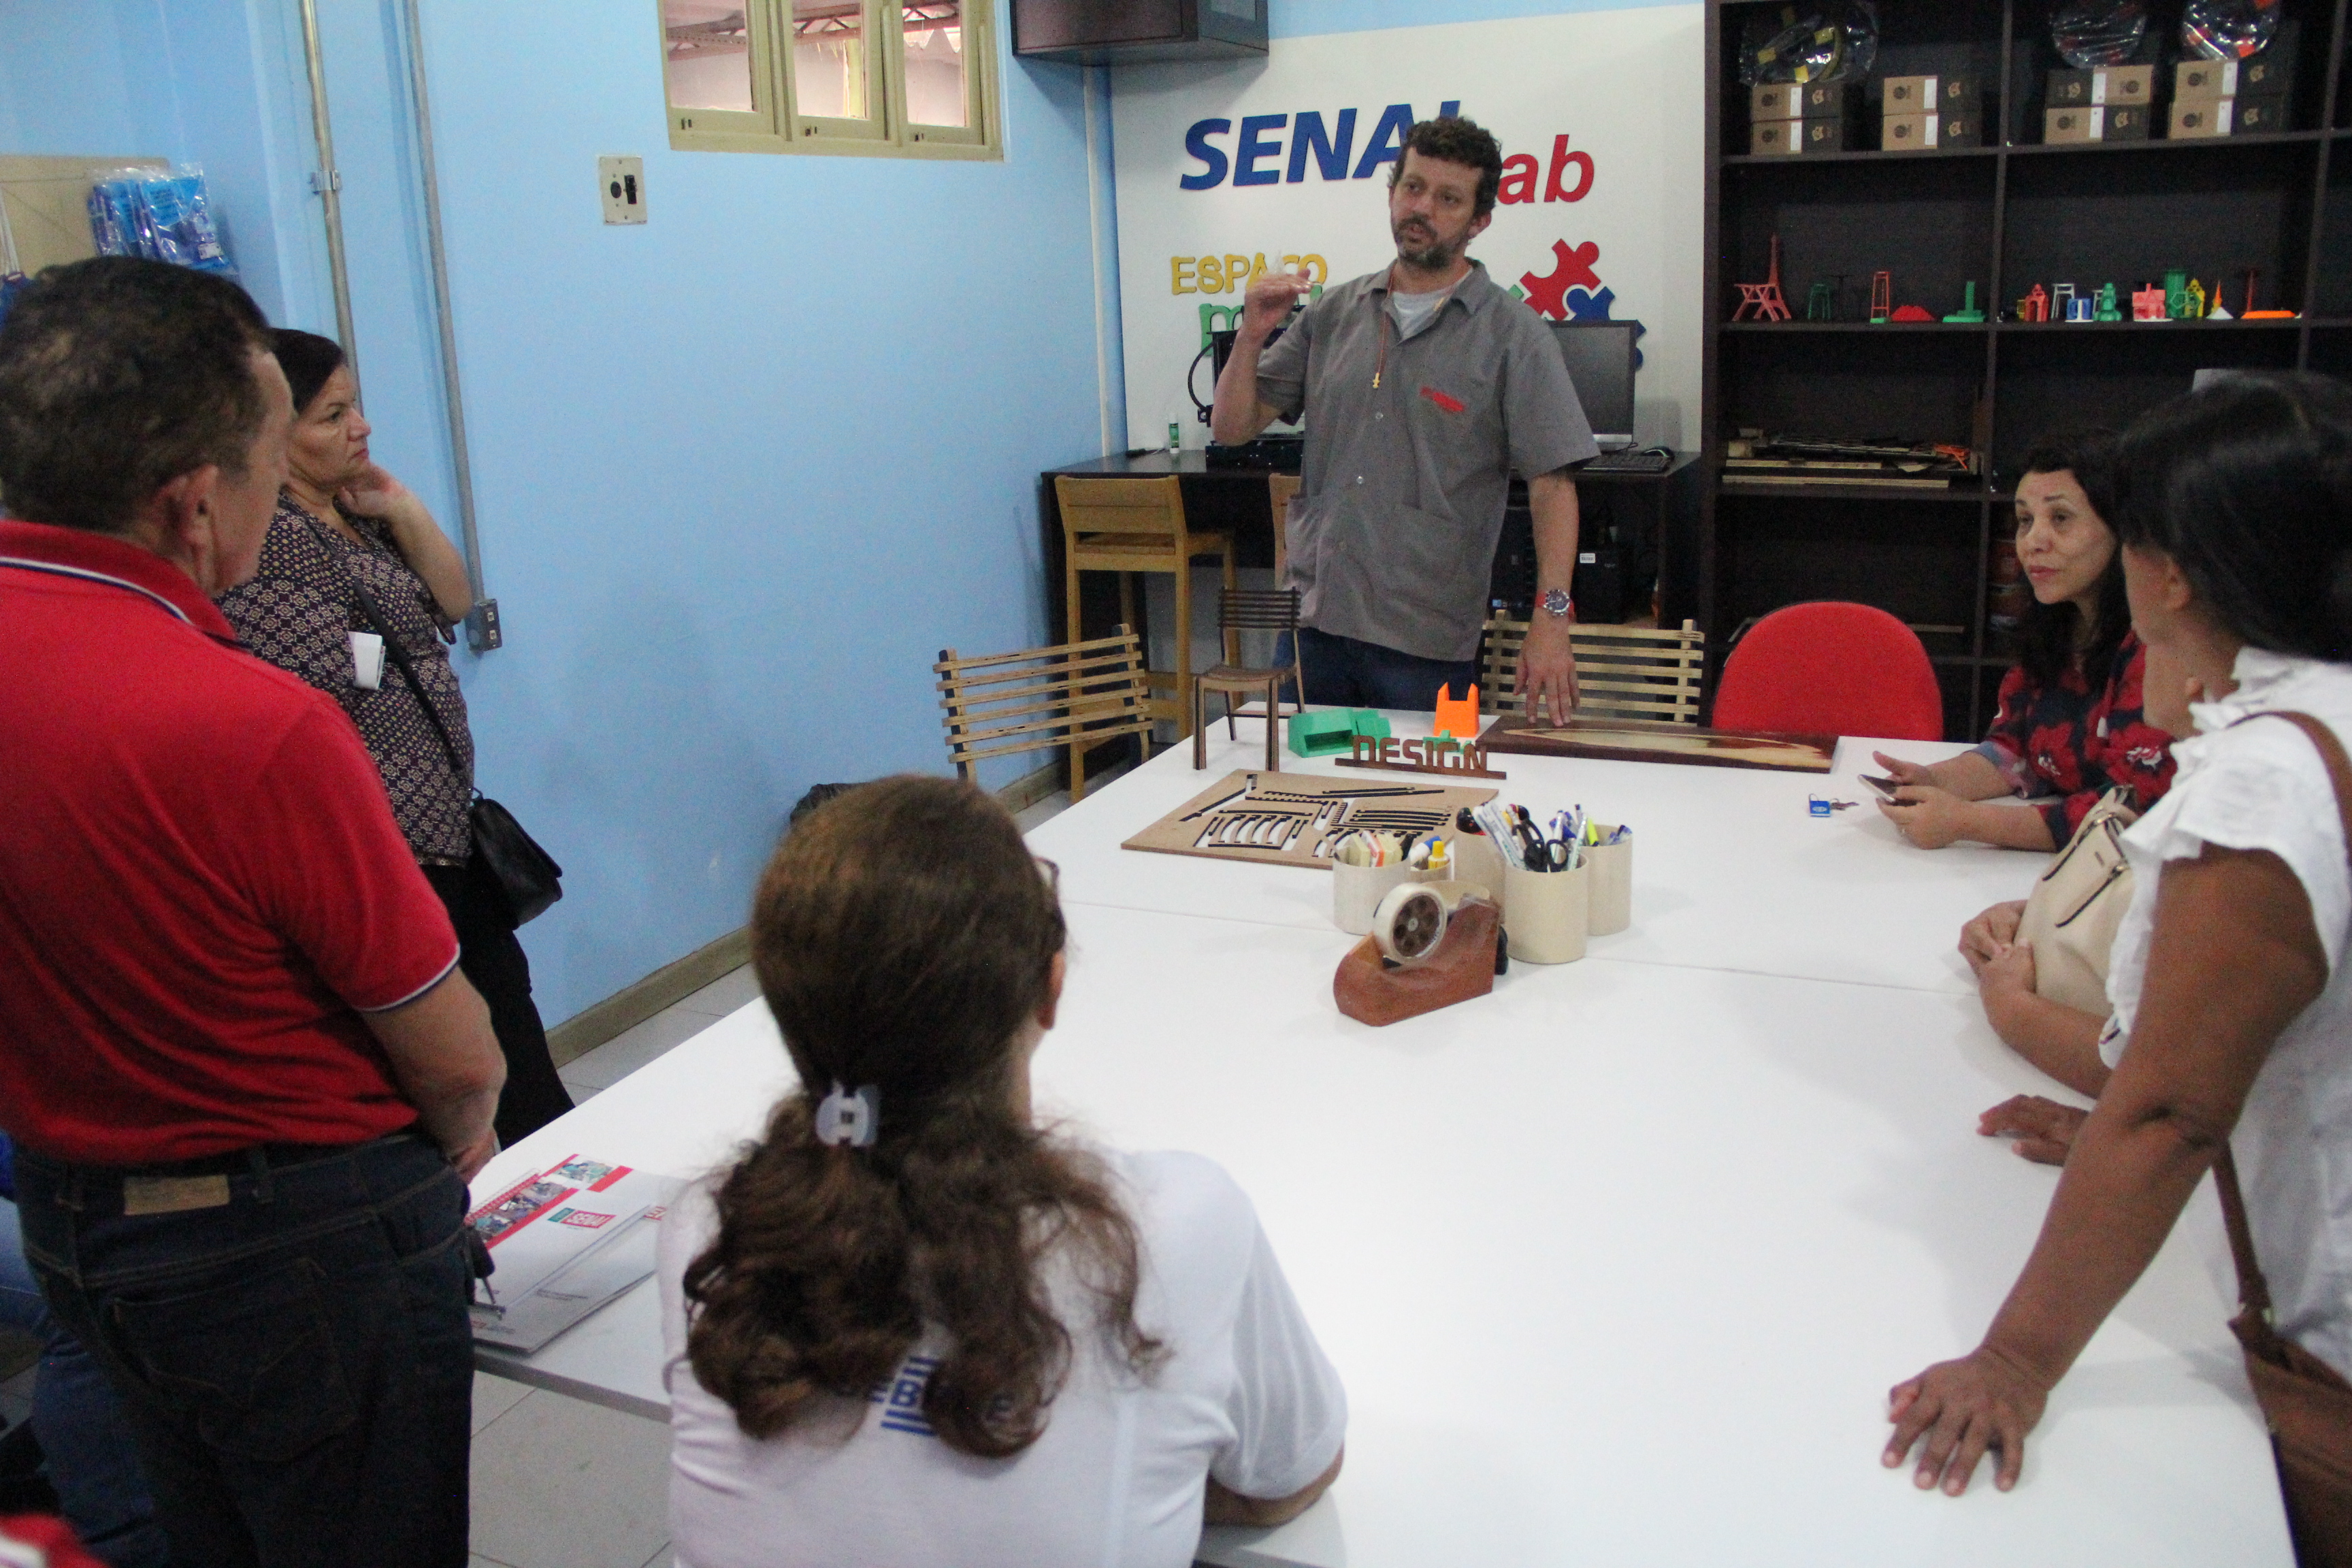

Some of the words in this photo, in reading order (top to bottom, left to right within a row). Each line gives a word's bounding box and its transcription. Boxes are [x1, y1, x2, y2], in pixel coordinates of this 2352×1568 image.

[1179, 100, 1460, 191] SENA
[1497, 134, 1595, 205] ab
[1351, 735, 1488, 772] DESIGN
